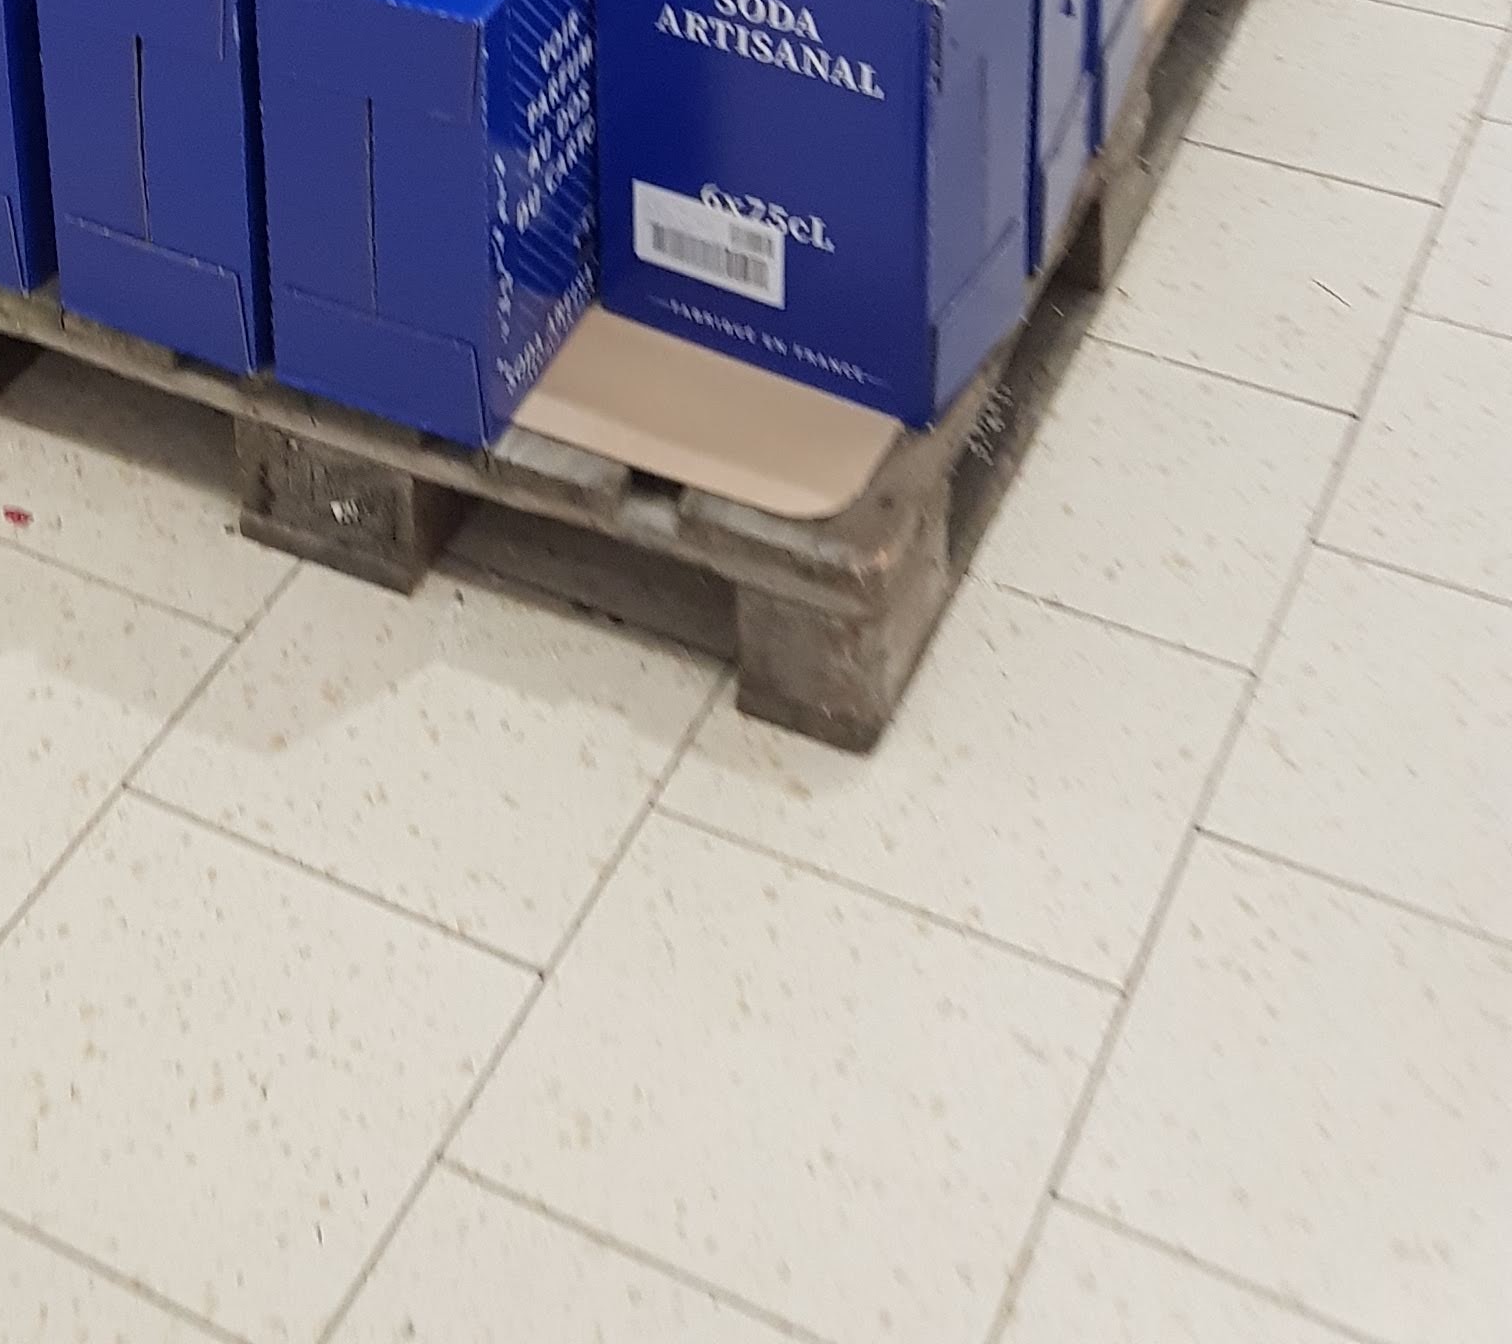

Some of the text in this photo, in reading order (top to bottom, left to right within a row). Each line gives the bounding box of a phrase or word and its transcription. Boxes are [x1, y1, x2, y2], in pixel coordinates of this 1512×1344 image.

[654, 1, 886, 102] ARTISANAL
[515, 112, 597, 235] DU CARTO
